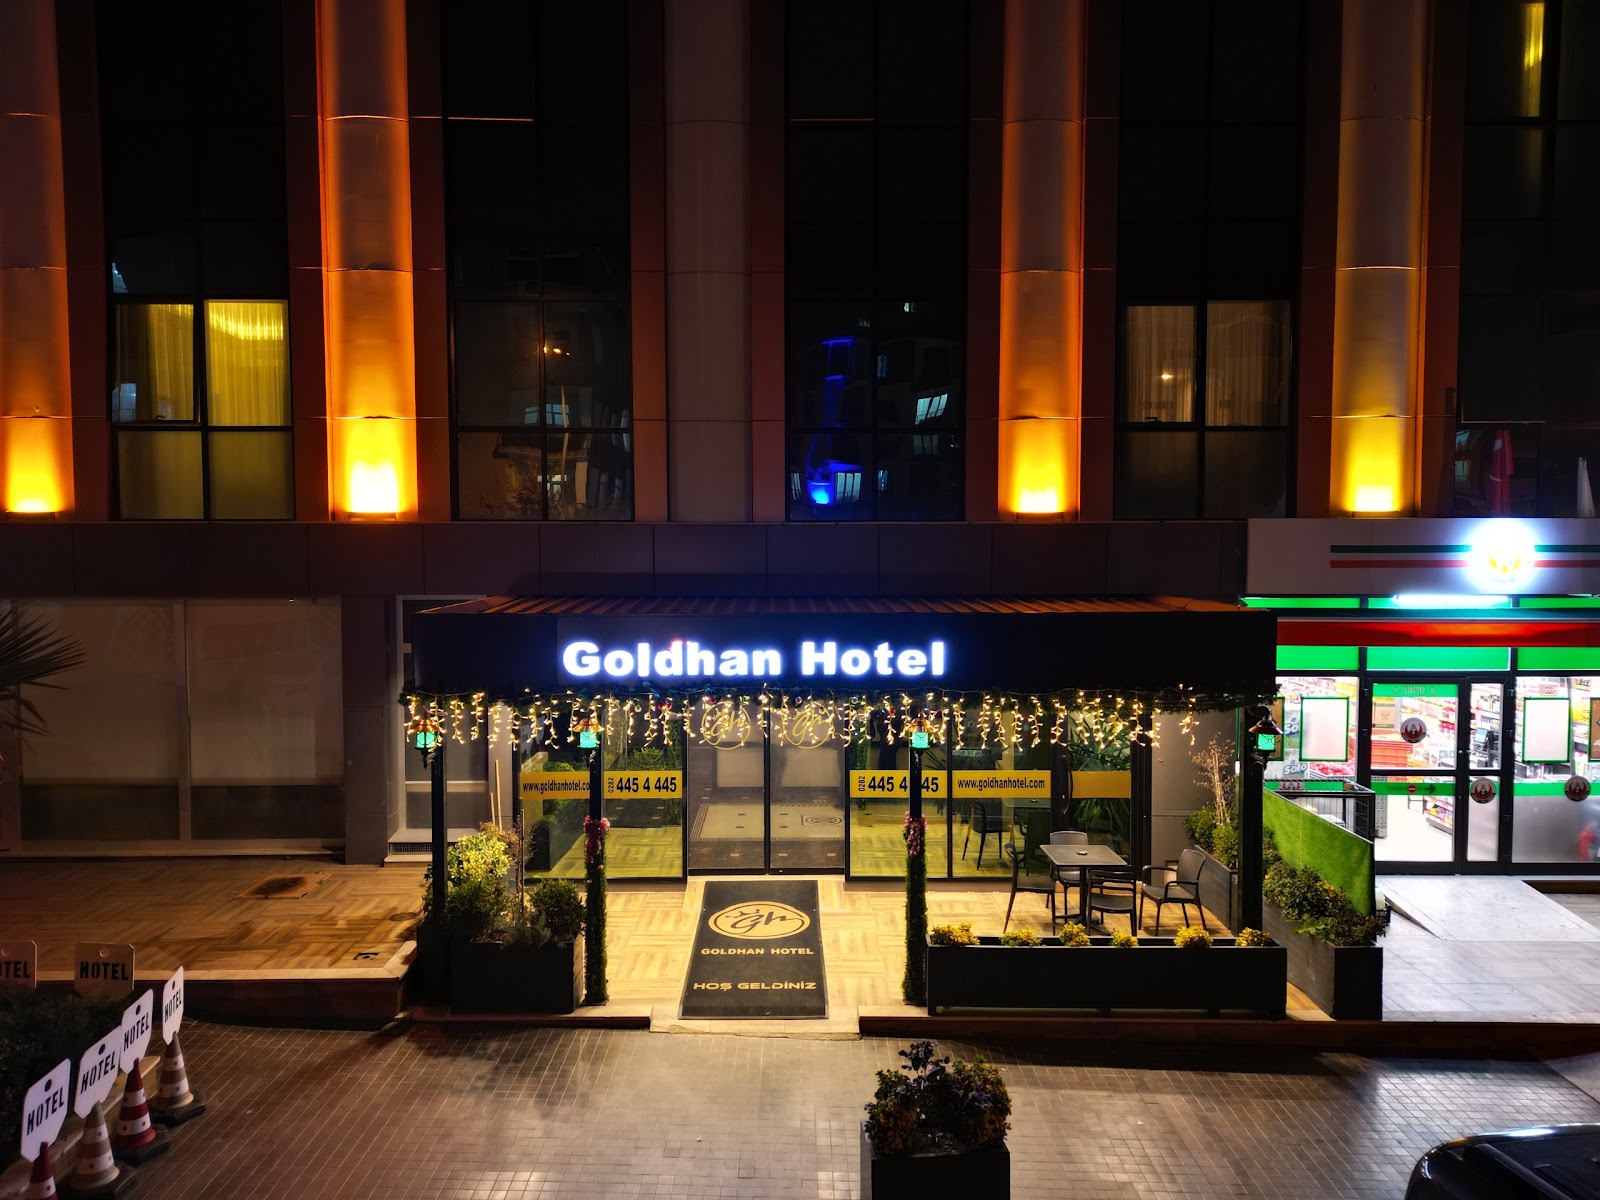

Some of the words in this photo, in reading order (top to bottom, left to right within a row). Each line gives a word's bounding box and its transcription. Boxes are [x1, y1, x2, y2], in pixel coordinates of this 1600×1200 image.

[563, 641, 781, 677] Goldhan
[801, 641, 945, 676] Hotel
[1283, 763, 1308, 775] Solo
[523, 779, 591, 794] www.goldhanhotel.co
[607, 777, 615, 793] 0282
[616, 777, 639, 793] 445
[643, 777, 650, 793] 4
[654, 777, 677, 793] 445
[858, 775, 866, 792] 0282
[868, 776, 895, 792] 445
[899, 776, 908, 792] 4
[920, 776, 939, 793] 45
[957, 777, 1046, 791] www.goldhanhotel.com
[0, 961, 31, 979] TEL
[79, 961, 129, 981] HOTEL
[693, 982, 733, 992] HOŞ
[737, 980, 817, 990] GELDİNİZ
[164, 988, 182, 1023] HOTEL
[123, 1012, 150, 1052] HOTEL
[80, 1050, 116, 1094] HOTEL
[26, 1086, 64, 1136] HOTEL
